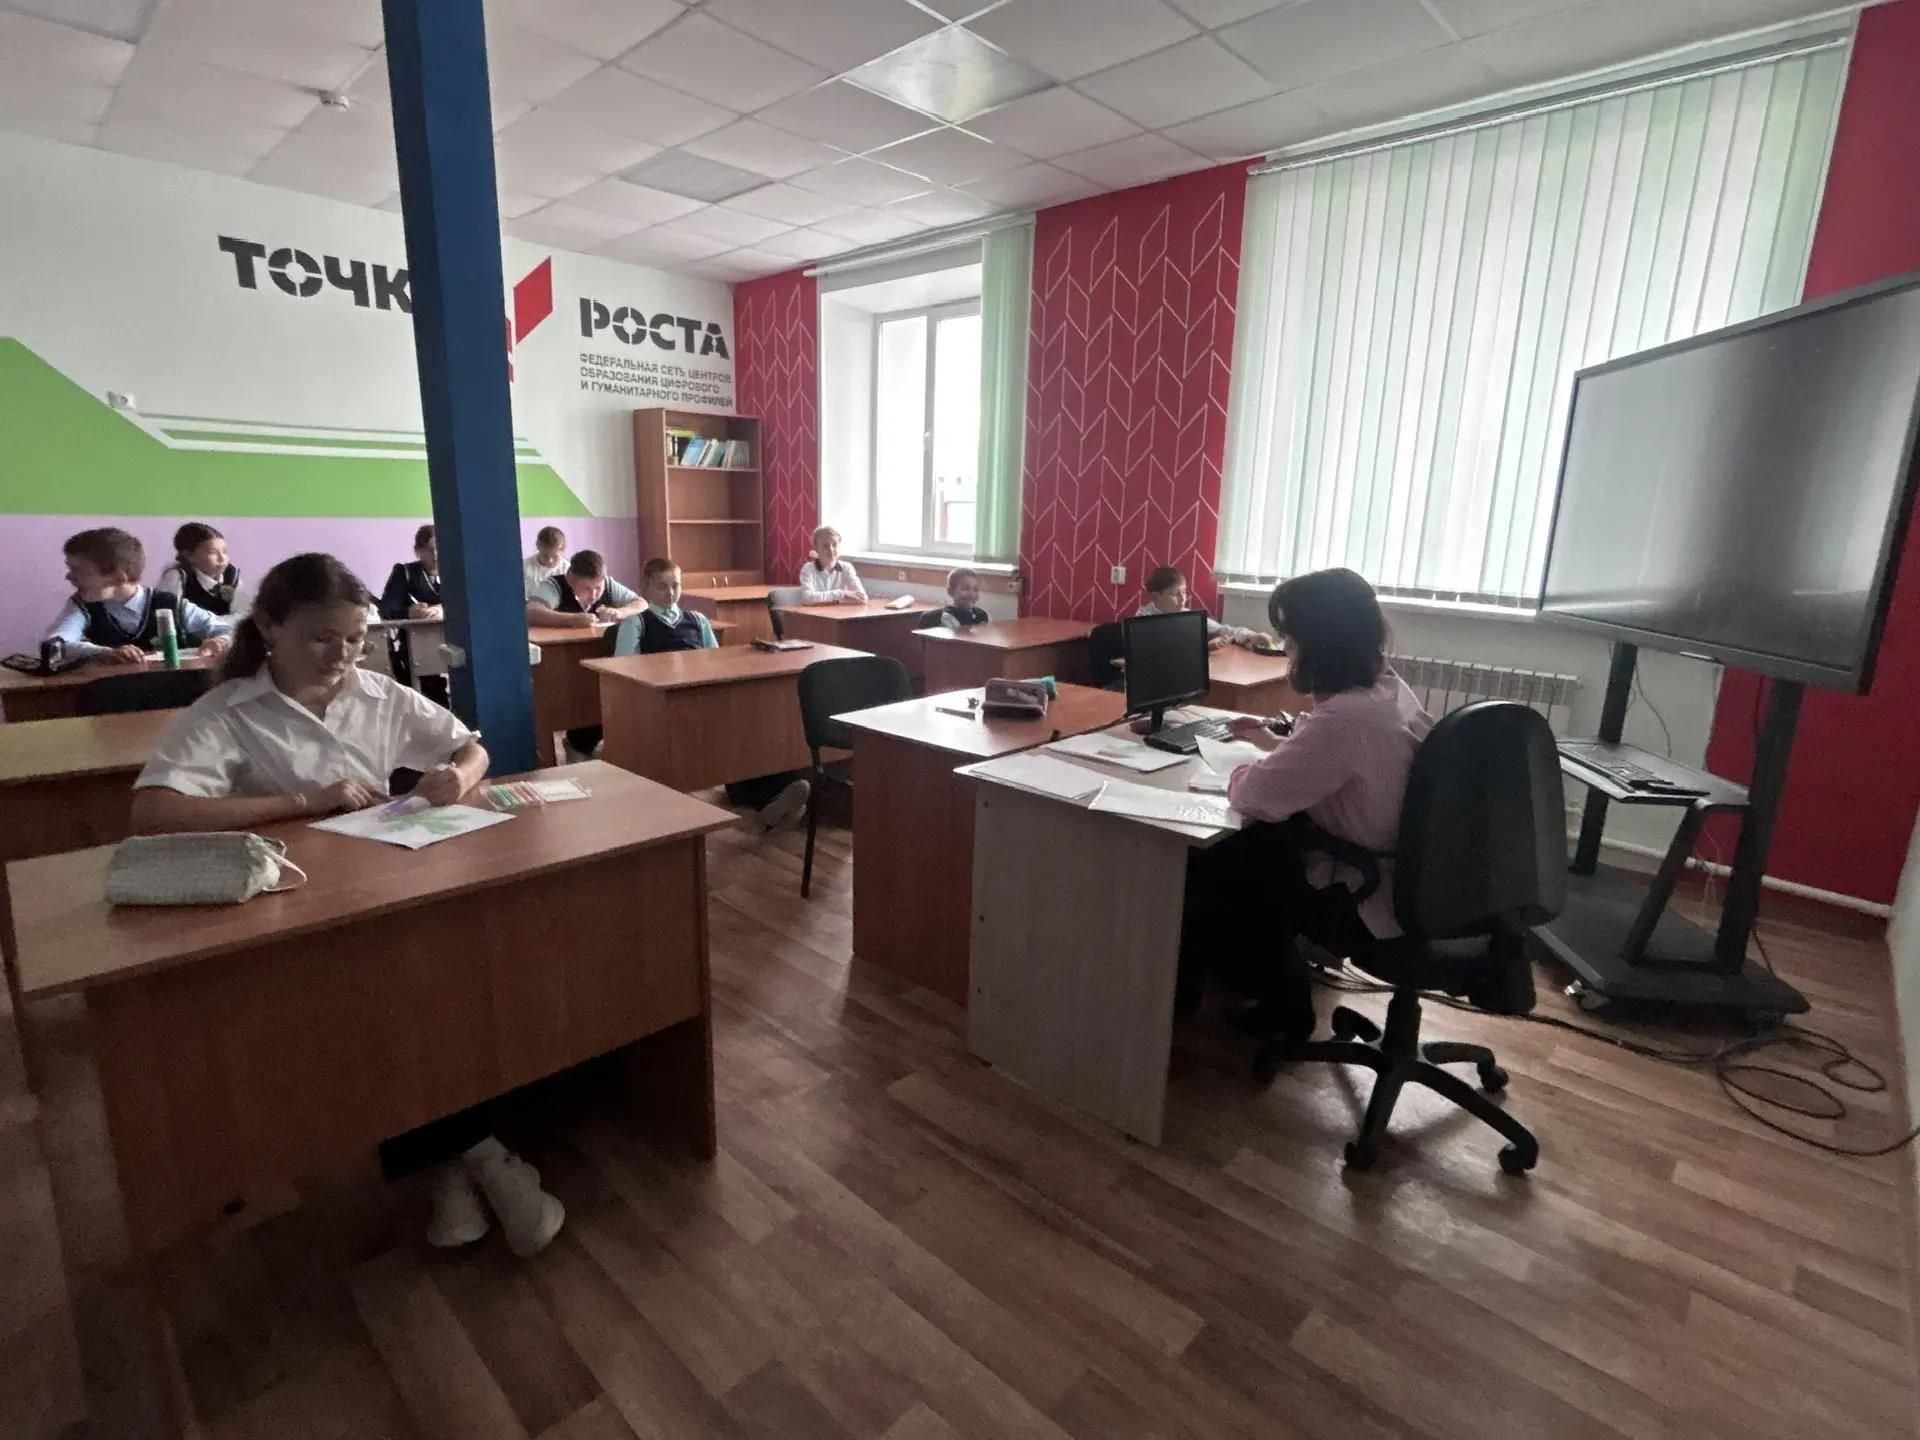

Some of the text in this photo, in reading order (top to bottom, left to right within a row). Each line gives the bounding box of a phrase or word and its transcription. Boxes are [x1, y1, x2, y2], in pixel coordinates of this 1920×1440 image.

[217, 234, 413, 314] ТОЧК
[580, 297, 730, 360] РОСТА
[580, 353, 732, 384] ФЕДЕРАЛЬНАЯ СЕТЬ ЦЕНТРОВ
[580, 366, 720, 394] ОБРАЗОВАНИЯ ЦИФРОВОГО
[580, 380, 733, 408] И ГУМАНИТАРНОГО ПРОФИЛЕЙ
